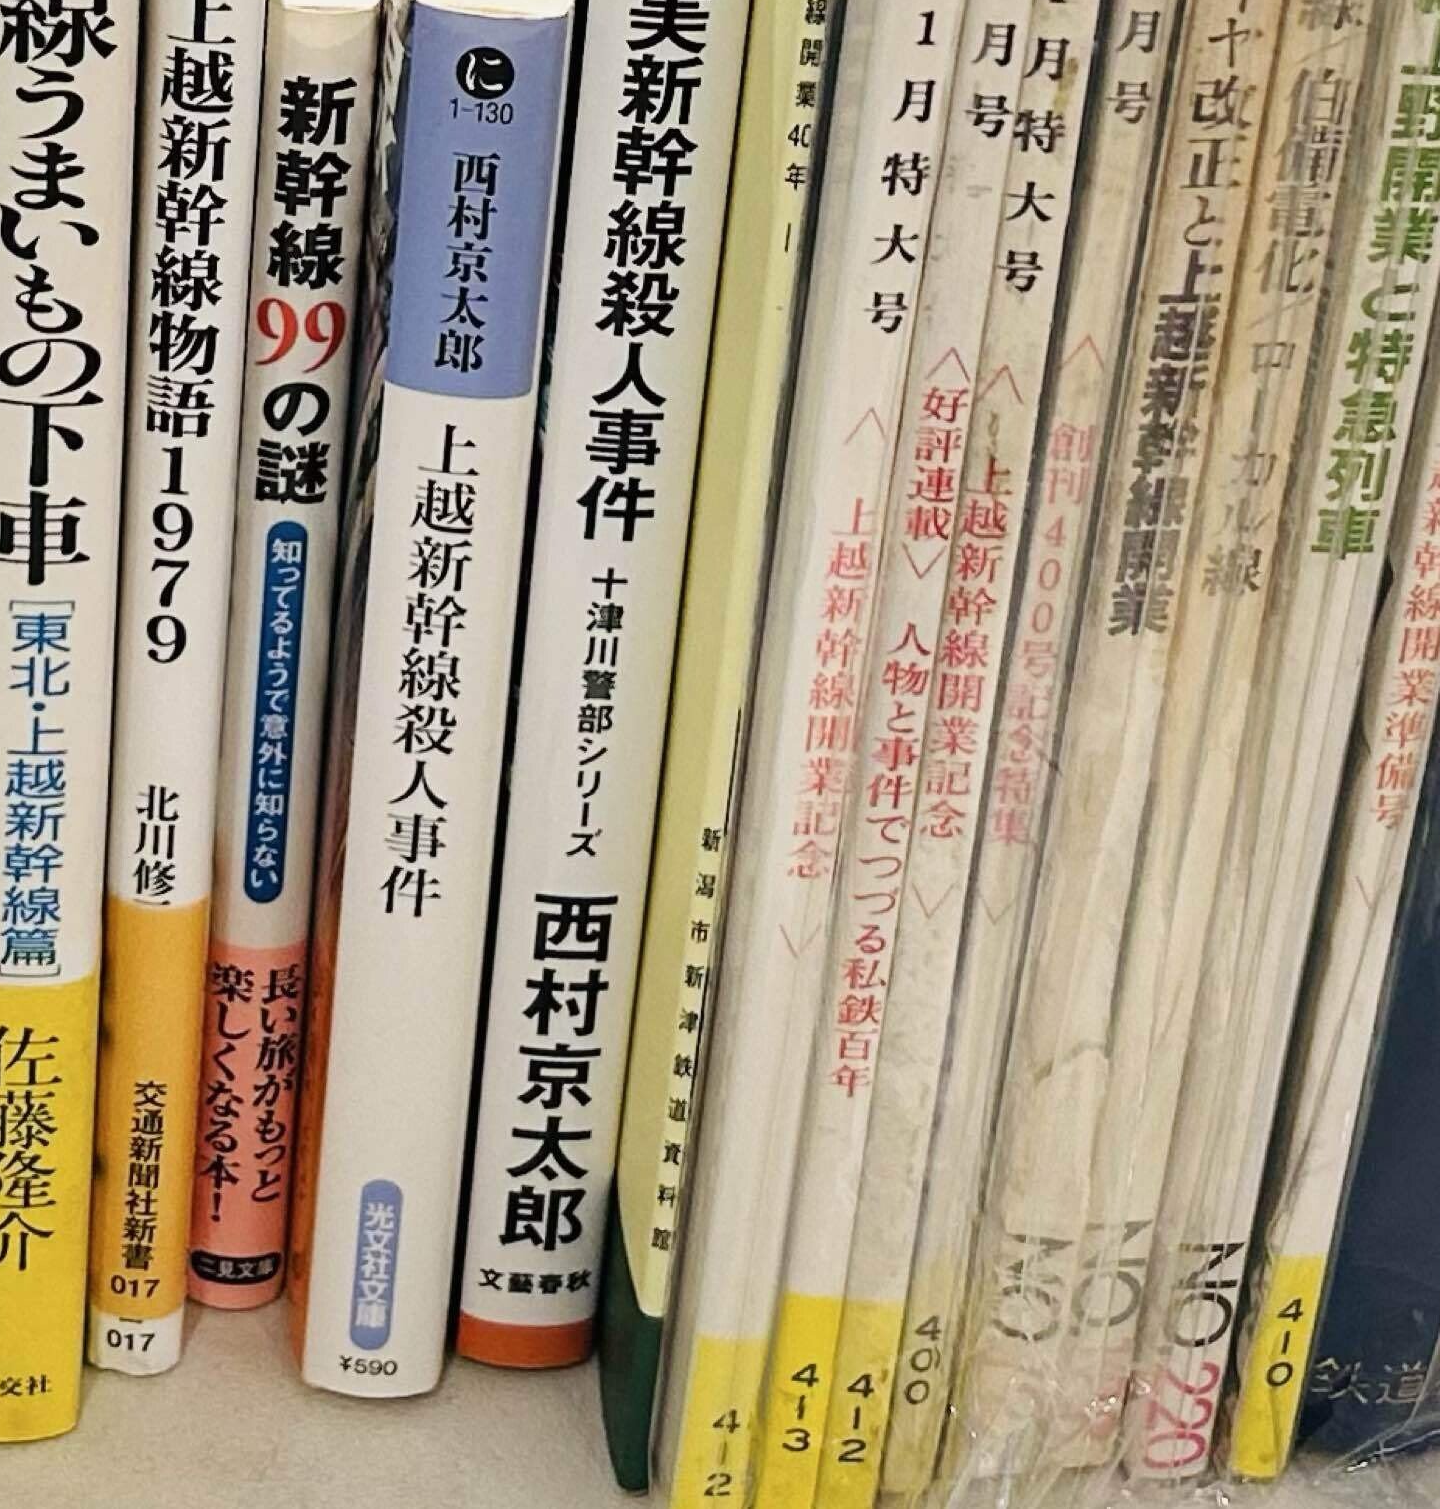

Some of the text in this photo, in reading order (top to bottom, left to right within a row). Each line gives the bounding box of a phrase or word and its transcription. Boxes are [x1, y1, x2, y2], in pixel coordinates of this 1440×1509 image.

[448, 101, 514, 127] 1-130
[254, 75, 357, 506] 新幹線99の謎
[432, 150, 502, 374] 西村京太郎
[249, 537, 305, 888] 知ってるようで意外に知らない
[379, 424, 480, 918] 上越新幹線殺人事件
[565, 566, 629, 859] 十津川警部シリーズ
[120, 1080, 169, 1273] 交通新聞社新書
[199, 963, 254, 1224] 楽しくなる本!
[250, 962, 303, 1204] 長い旅がもっと
[497, 893, 619, 1252] 西村京太郎
[105, 1328, 157, 1352] 017
[109, 1274, 161, 1299] 017
[338, 1355, 399, 1378] ¥590
[355, 1202, 397, 1329] 光文社文庫
[478, 1267, 594, 1295] 文藝春秋
